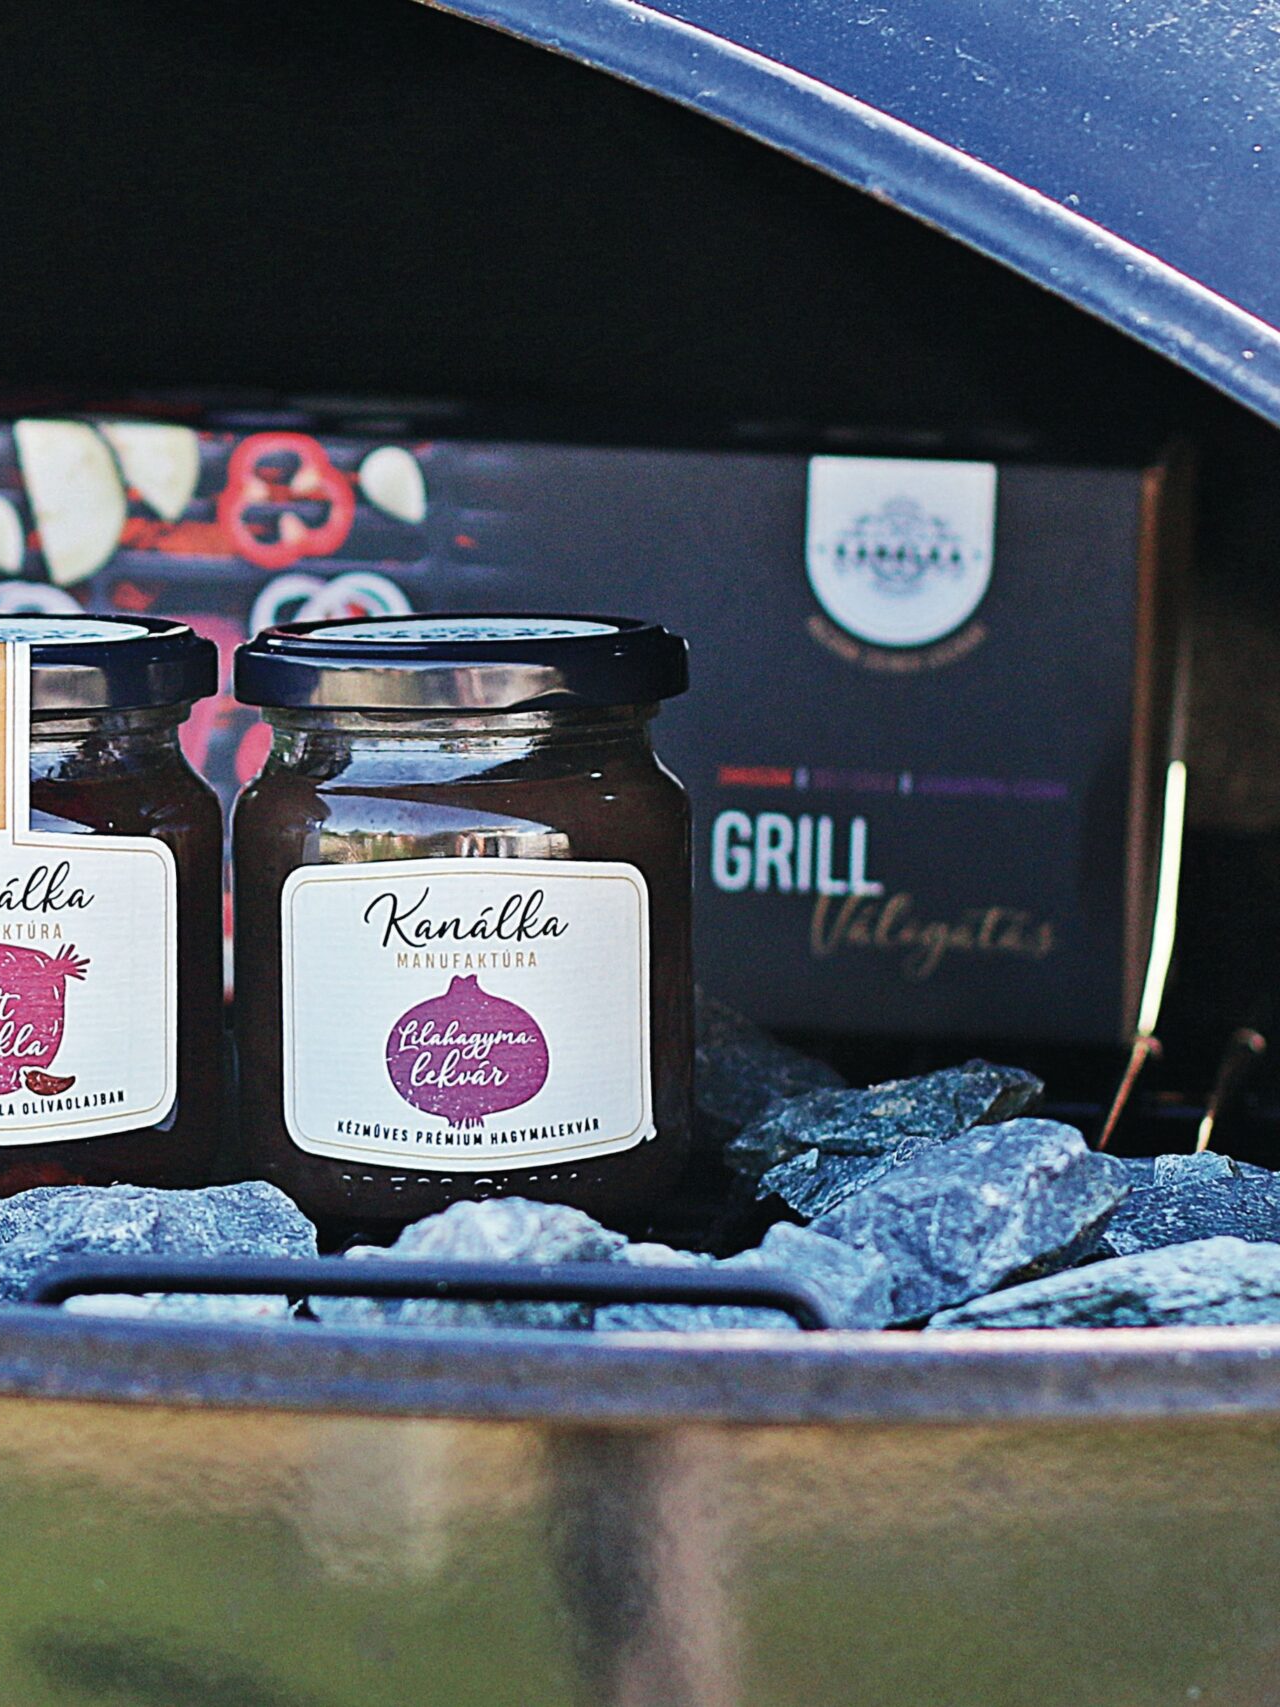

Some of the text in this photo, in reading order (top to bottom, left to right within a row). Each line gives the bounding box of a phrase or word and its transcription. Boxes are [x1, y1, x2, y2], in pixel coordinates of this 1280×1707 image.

[711, 809, 885, 896] GRILL
[364, 887, 569, 948] Kanálka
[396, 949, 538, 969] MANUFAKTÚRA
[410, 1048, 510, 1089] lekvár
[22, 1090, 125, 1115] OLÍVAOLAJBAN
[416, 1129, 483, 1146] PRÉMIUM
[491, 1117, 600, 1145] HAGYMALEKVÁR
